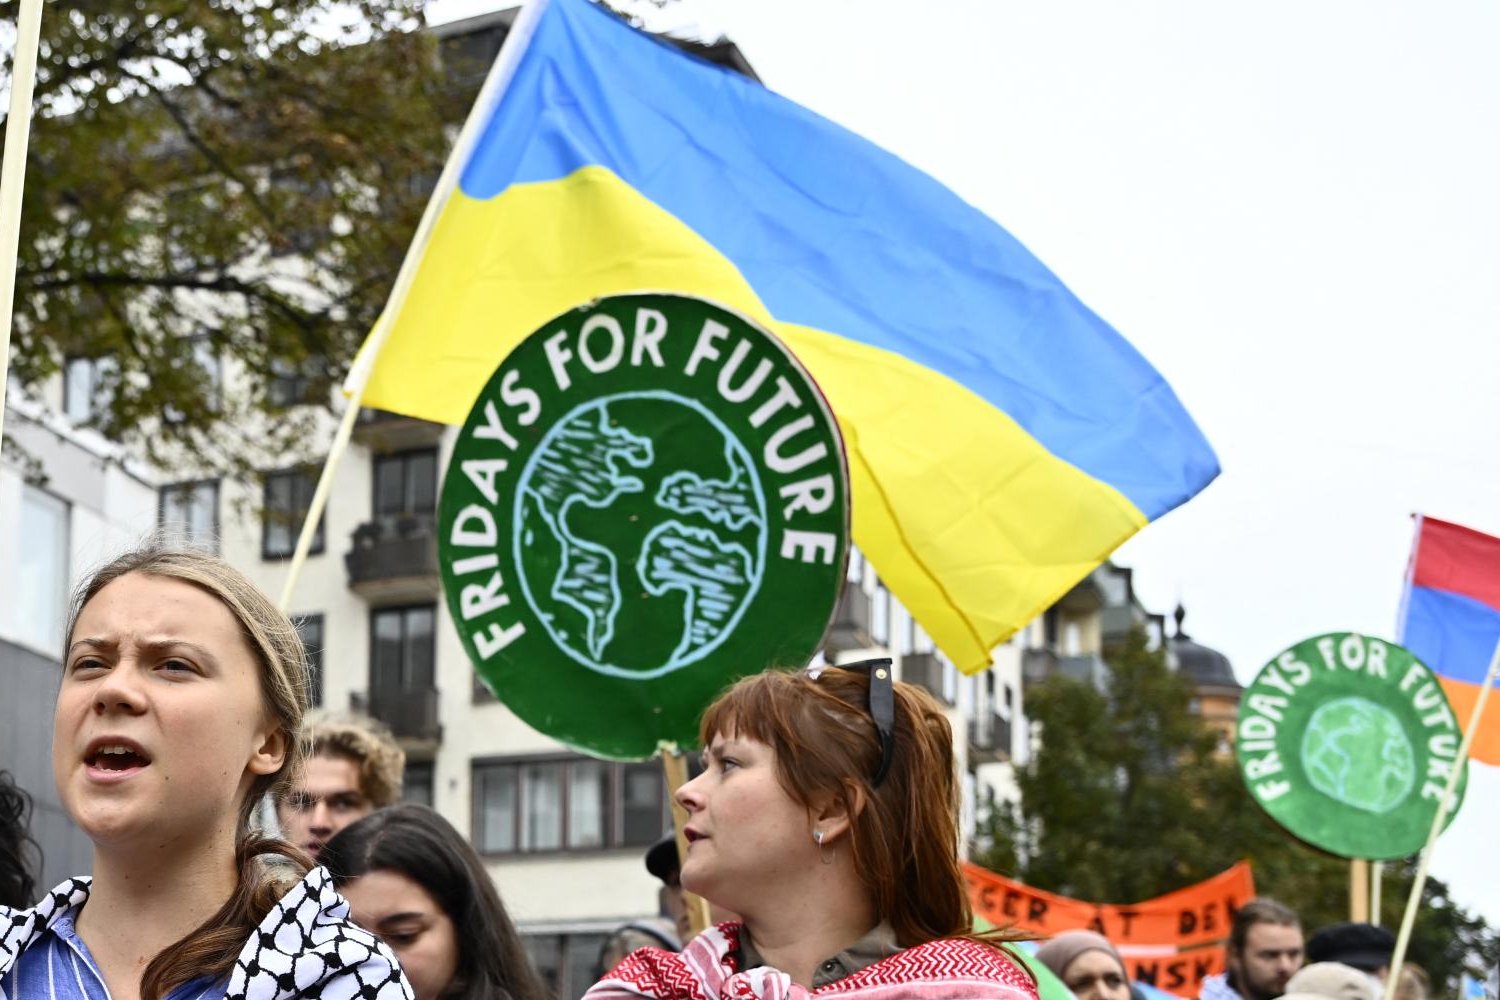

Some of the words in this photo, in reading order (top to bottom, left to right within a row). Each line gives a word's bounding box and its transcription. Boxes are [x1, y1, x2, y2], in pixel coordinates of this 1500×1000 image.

[450, 368, 542, 661] FRIDAYS
[543, 307, 668, 391] FOR
[684, 318, 837, 566] FUTURE
[1239, 651, 1311, 802] FRIDAYS
[1317, 634, 1388, 679] FOR
[969, 879, 1050, 925] GER
